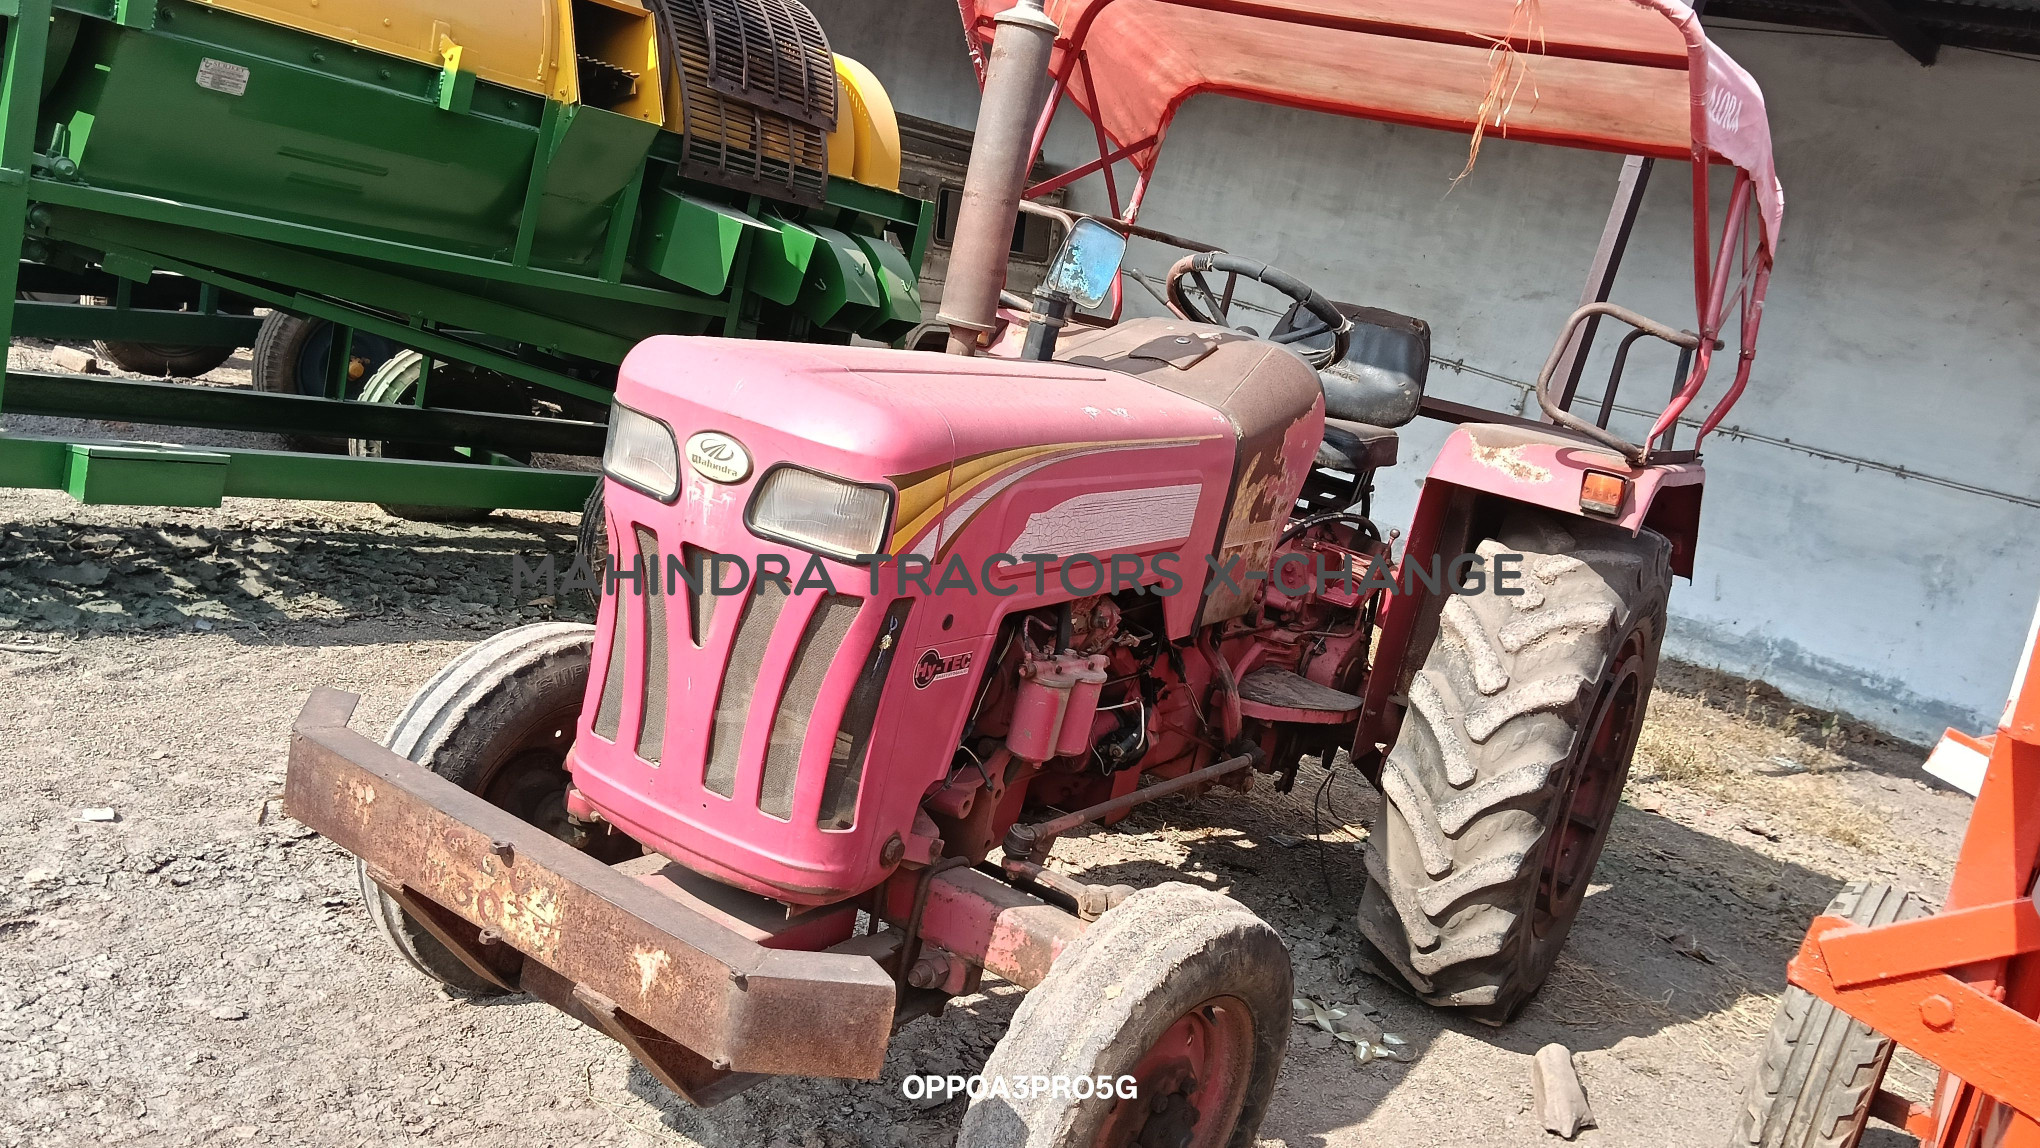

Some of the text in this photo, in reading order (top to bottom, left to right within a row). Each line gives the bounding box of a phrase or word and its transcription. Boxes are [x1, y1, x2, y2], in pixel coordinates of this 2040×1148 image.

[691, 453, 738, 477] Mahindra
[534, 663, 591, 698] SUP
[914, 653, 972, 681] Hy-TEC
